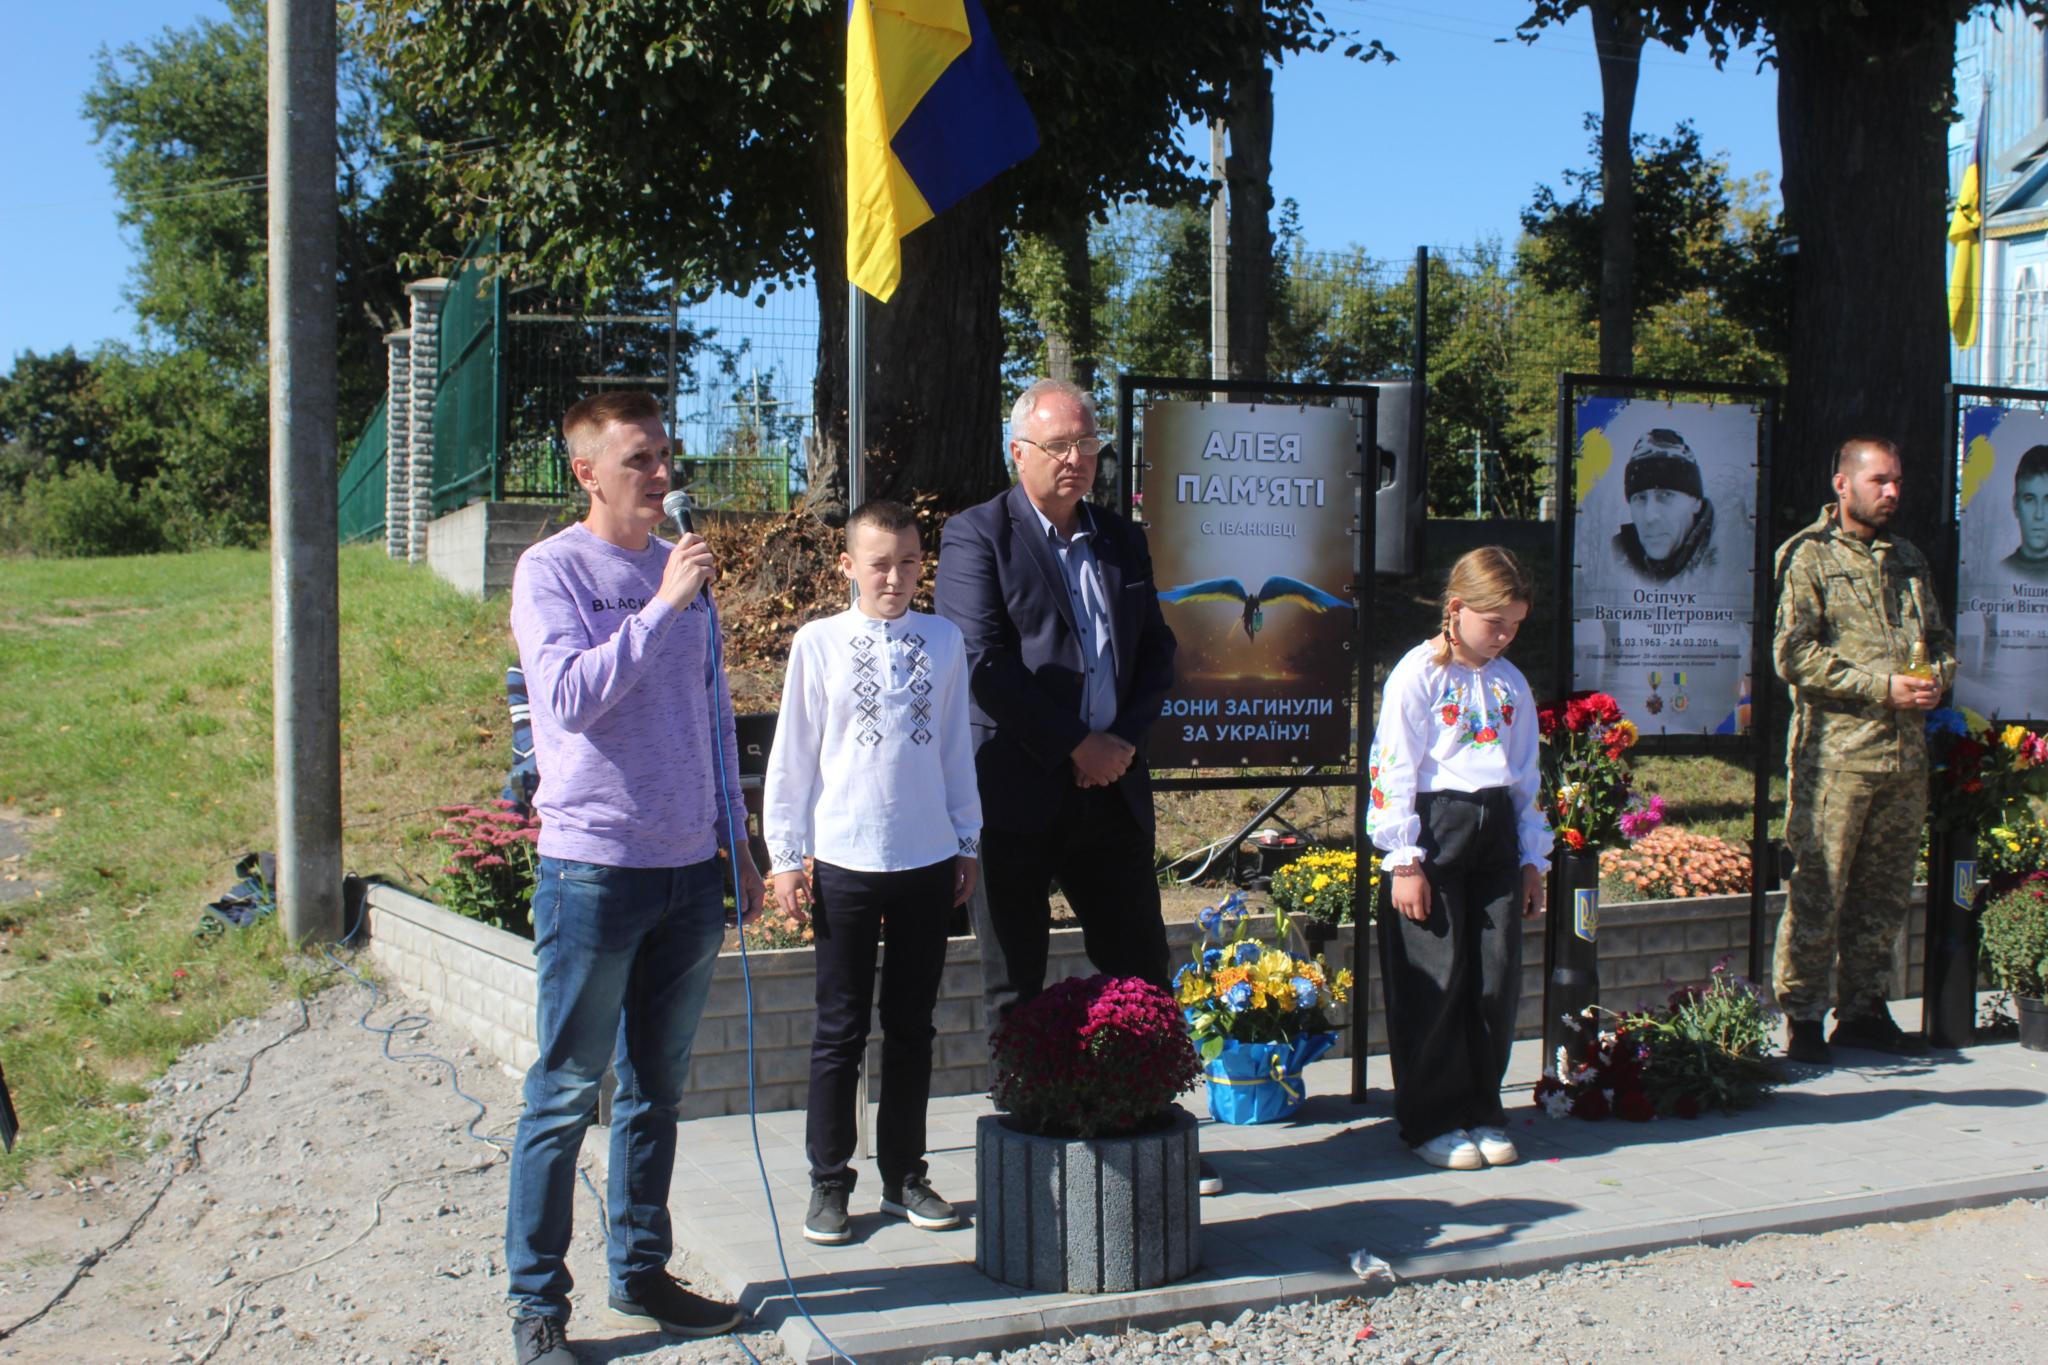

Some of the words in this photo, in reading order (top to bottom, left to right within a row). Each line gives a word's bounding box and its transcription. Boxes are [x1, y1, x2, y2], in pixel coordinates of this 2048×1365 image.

[1203, 431, 1301, 462] АЛЕЯ
[1178, 473, 1325, 506] ПАМ’ЯТІ
[1220, 521, 1297, 539] ІВАНКІВЦІ
[1633, 588, 1697, 607] Осіпчук
[1970, 598, 2014, 615] Сергій
[2018, 600, 2048, 613] Вікт
[1595, 605, 1652, 620] Василь
[1656, 606, 1733, 624] Петрович
[1160, 699, 1218, 716] ВОНИ
[1225, 699, 1333, 716] ЗАГИНУЛИ
[1182, 725, 1209, 741] ЗА
[1216, 720, 1310, 741] УКРАЇНУ!
